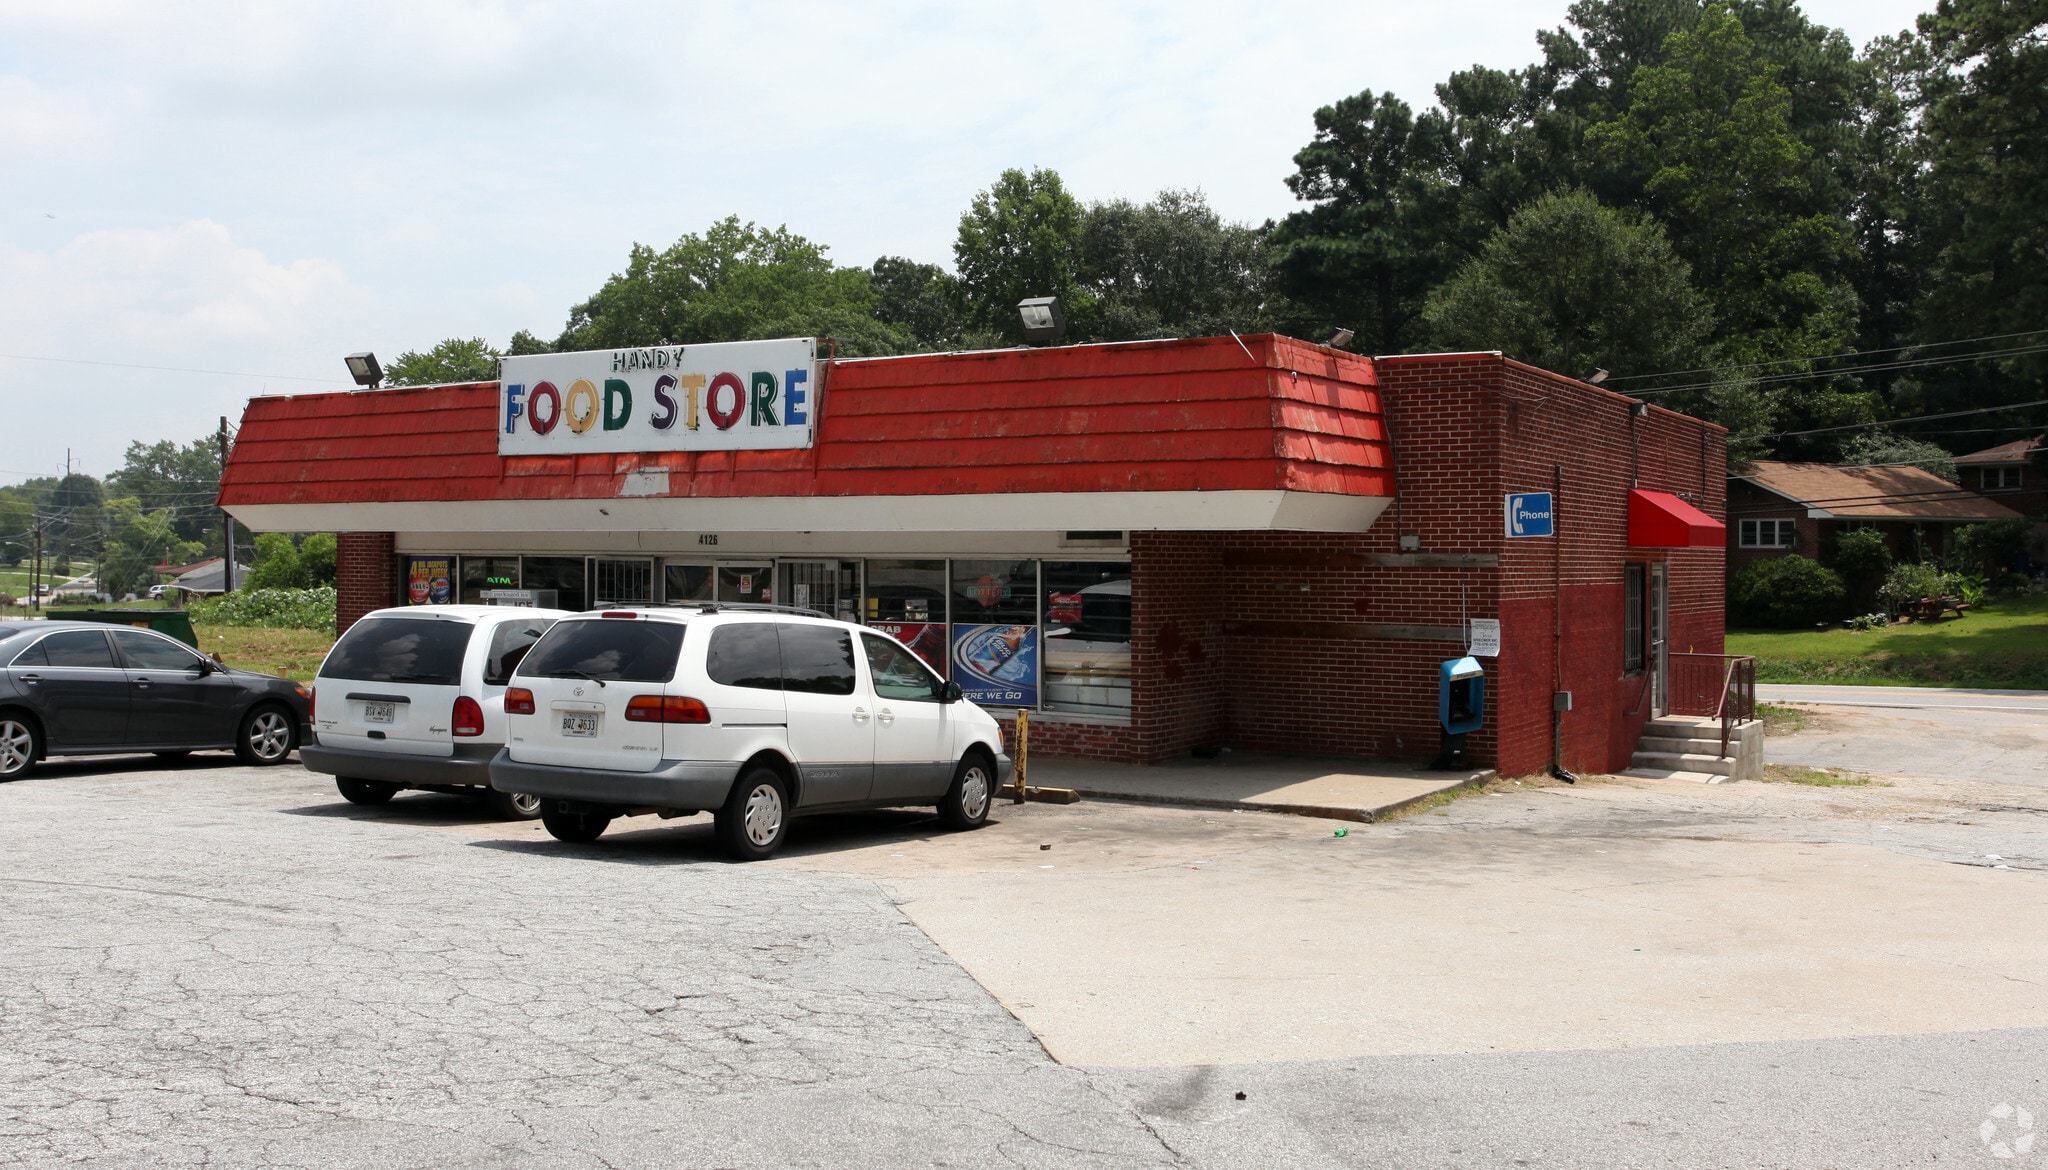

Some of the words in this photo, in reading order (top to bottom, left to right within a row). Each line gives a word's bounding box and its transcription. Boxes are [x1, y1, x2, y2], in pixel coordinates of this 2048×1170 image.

[610, 347, 684, 372] HANDY
[506, 378, 633, 435] FOOD
[651, 369, 807, 430] STORE
[1520, 511, 1550, 520] Phone
[698, 534, 718, 545] 4126
[410, 561, 418, 577] 4
[431, 568, 448, 578] WEEK
[968, 588, 1009, 597] LOTTERY
[996, 639, 1011, 655] BUD
[986, 692, 1002, 700] WE
[1005, 691, 1022, 700] GO
[563, 718, 576, 729] BQZ
